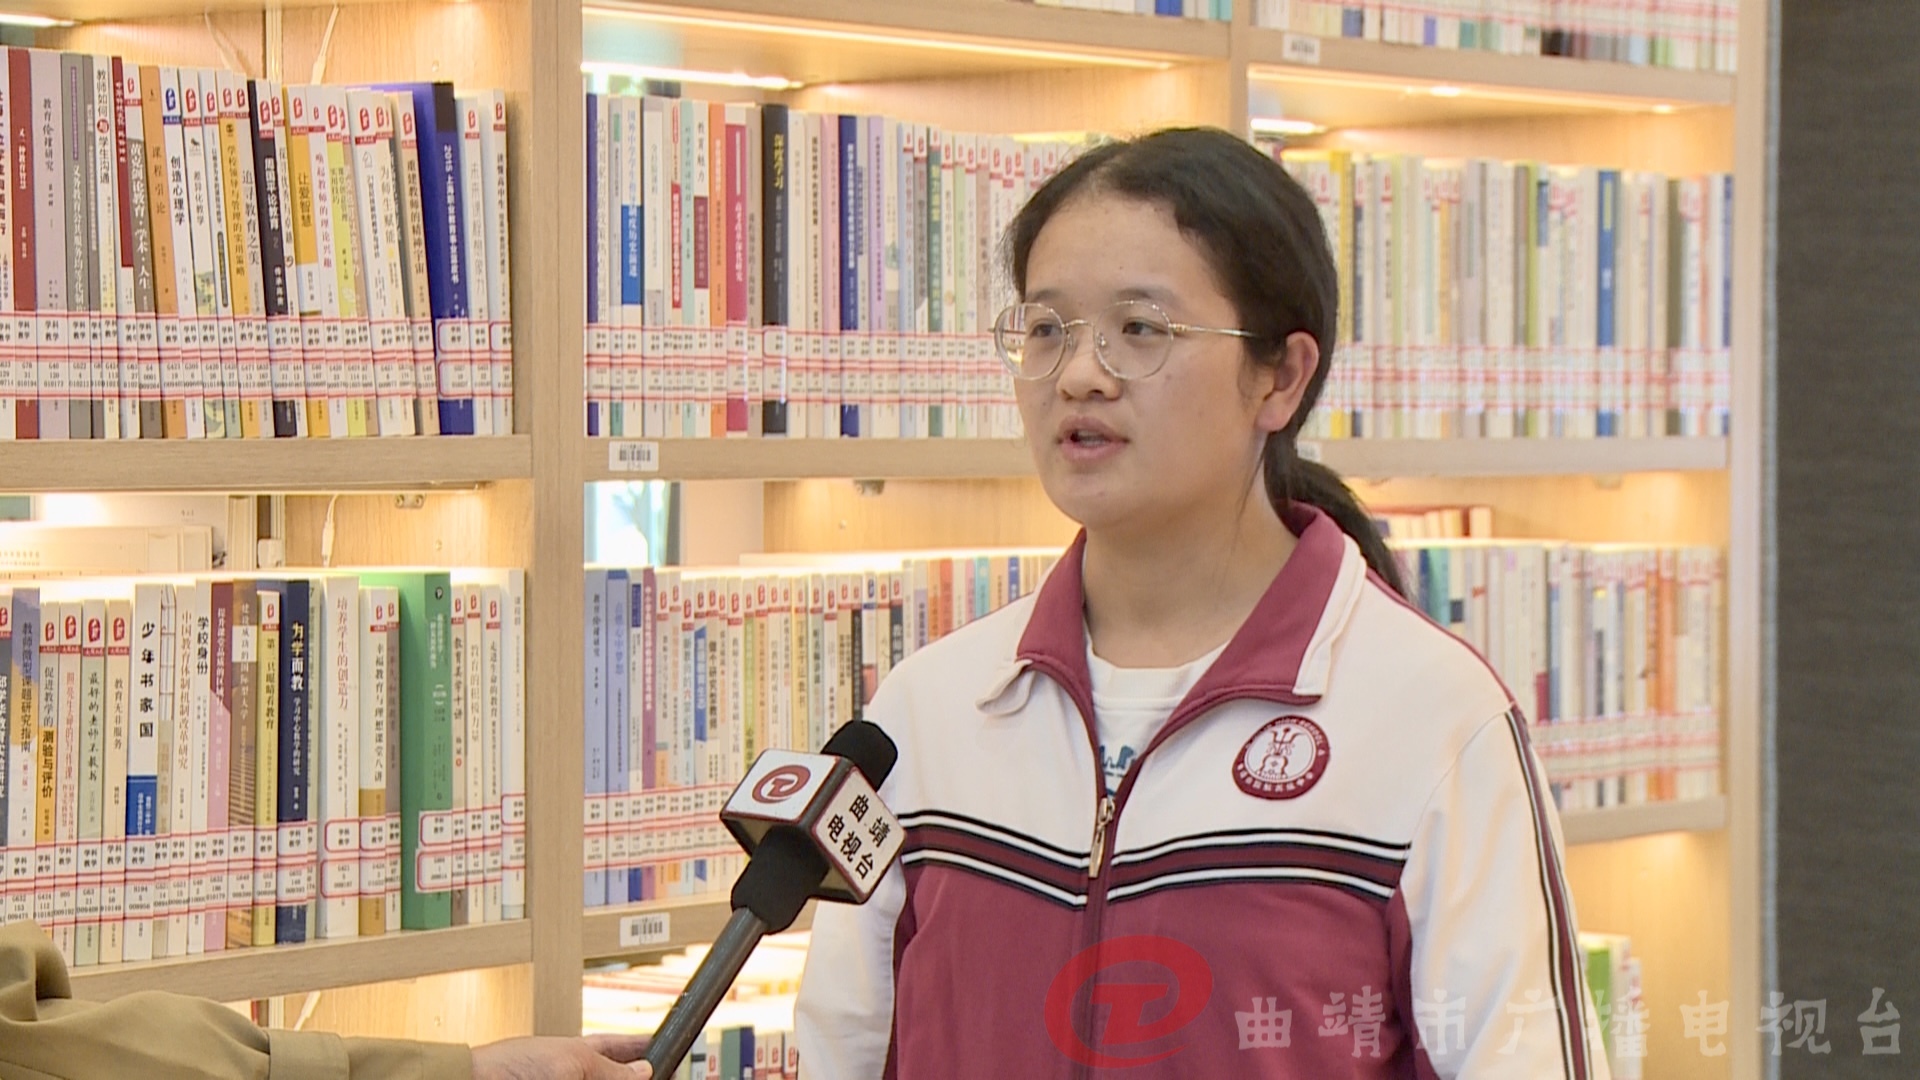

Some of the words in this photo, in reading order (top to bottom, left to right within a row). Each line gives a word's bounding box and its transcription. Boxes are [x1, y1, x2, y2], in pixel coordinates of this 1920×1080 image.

[43, 98, 55, 172] 教育伦理研究
[443, 144, 453, 173] 2015
[152, 147, 165, 214] 课程引论
[170, 157, 186, 226] 创造心理学
[242, 170, 260, 266] 追寻教育之美
[407, 159, 425, 275] 重建教师的精神宇宙
[140, 621, 155, 738] 少年书家国
[197, 616, 209, 676] 学校身份
[290, 621, 305, 692] 为学而教
[336, 596, 349, 711] 培养学生的创造力
[114, 679, 123, 750] 教育无非服务
[178, 610, 192, 770] 中国教育体制机制改革研究
[374, 643, 384, 783] 幸福教育与理想课堂八讲
[88, 672, 100, 782] 最好的老师不教书
[827, 813, 875, 879] 电视台
[849, 794, 892, 848] 曲靖
